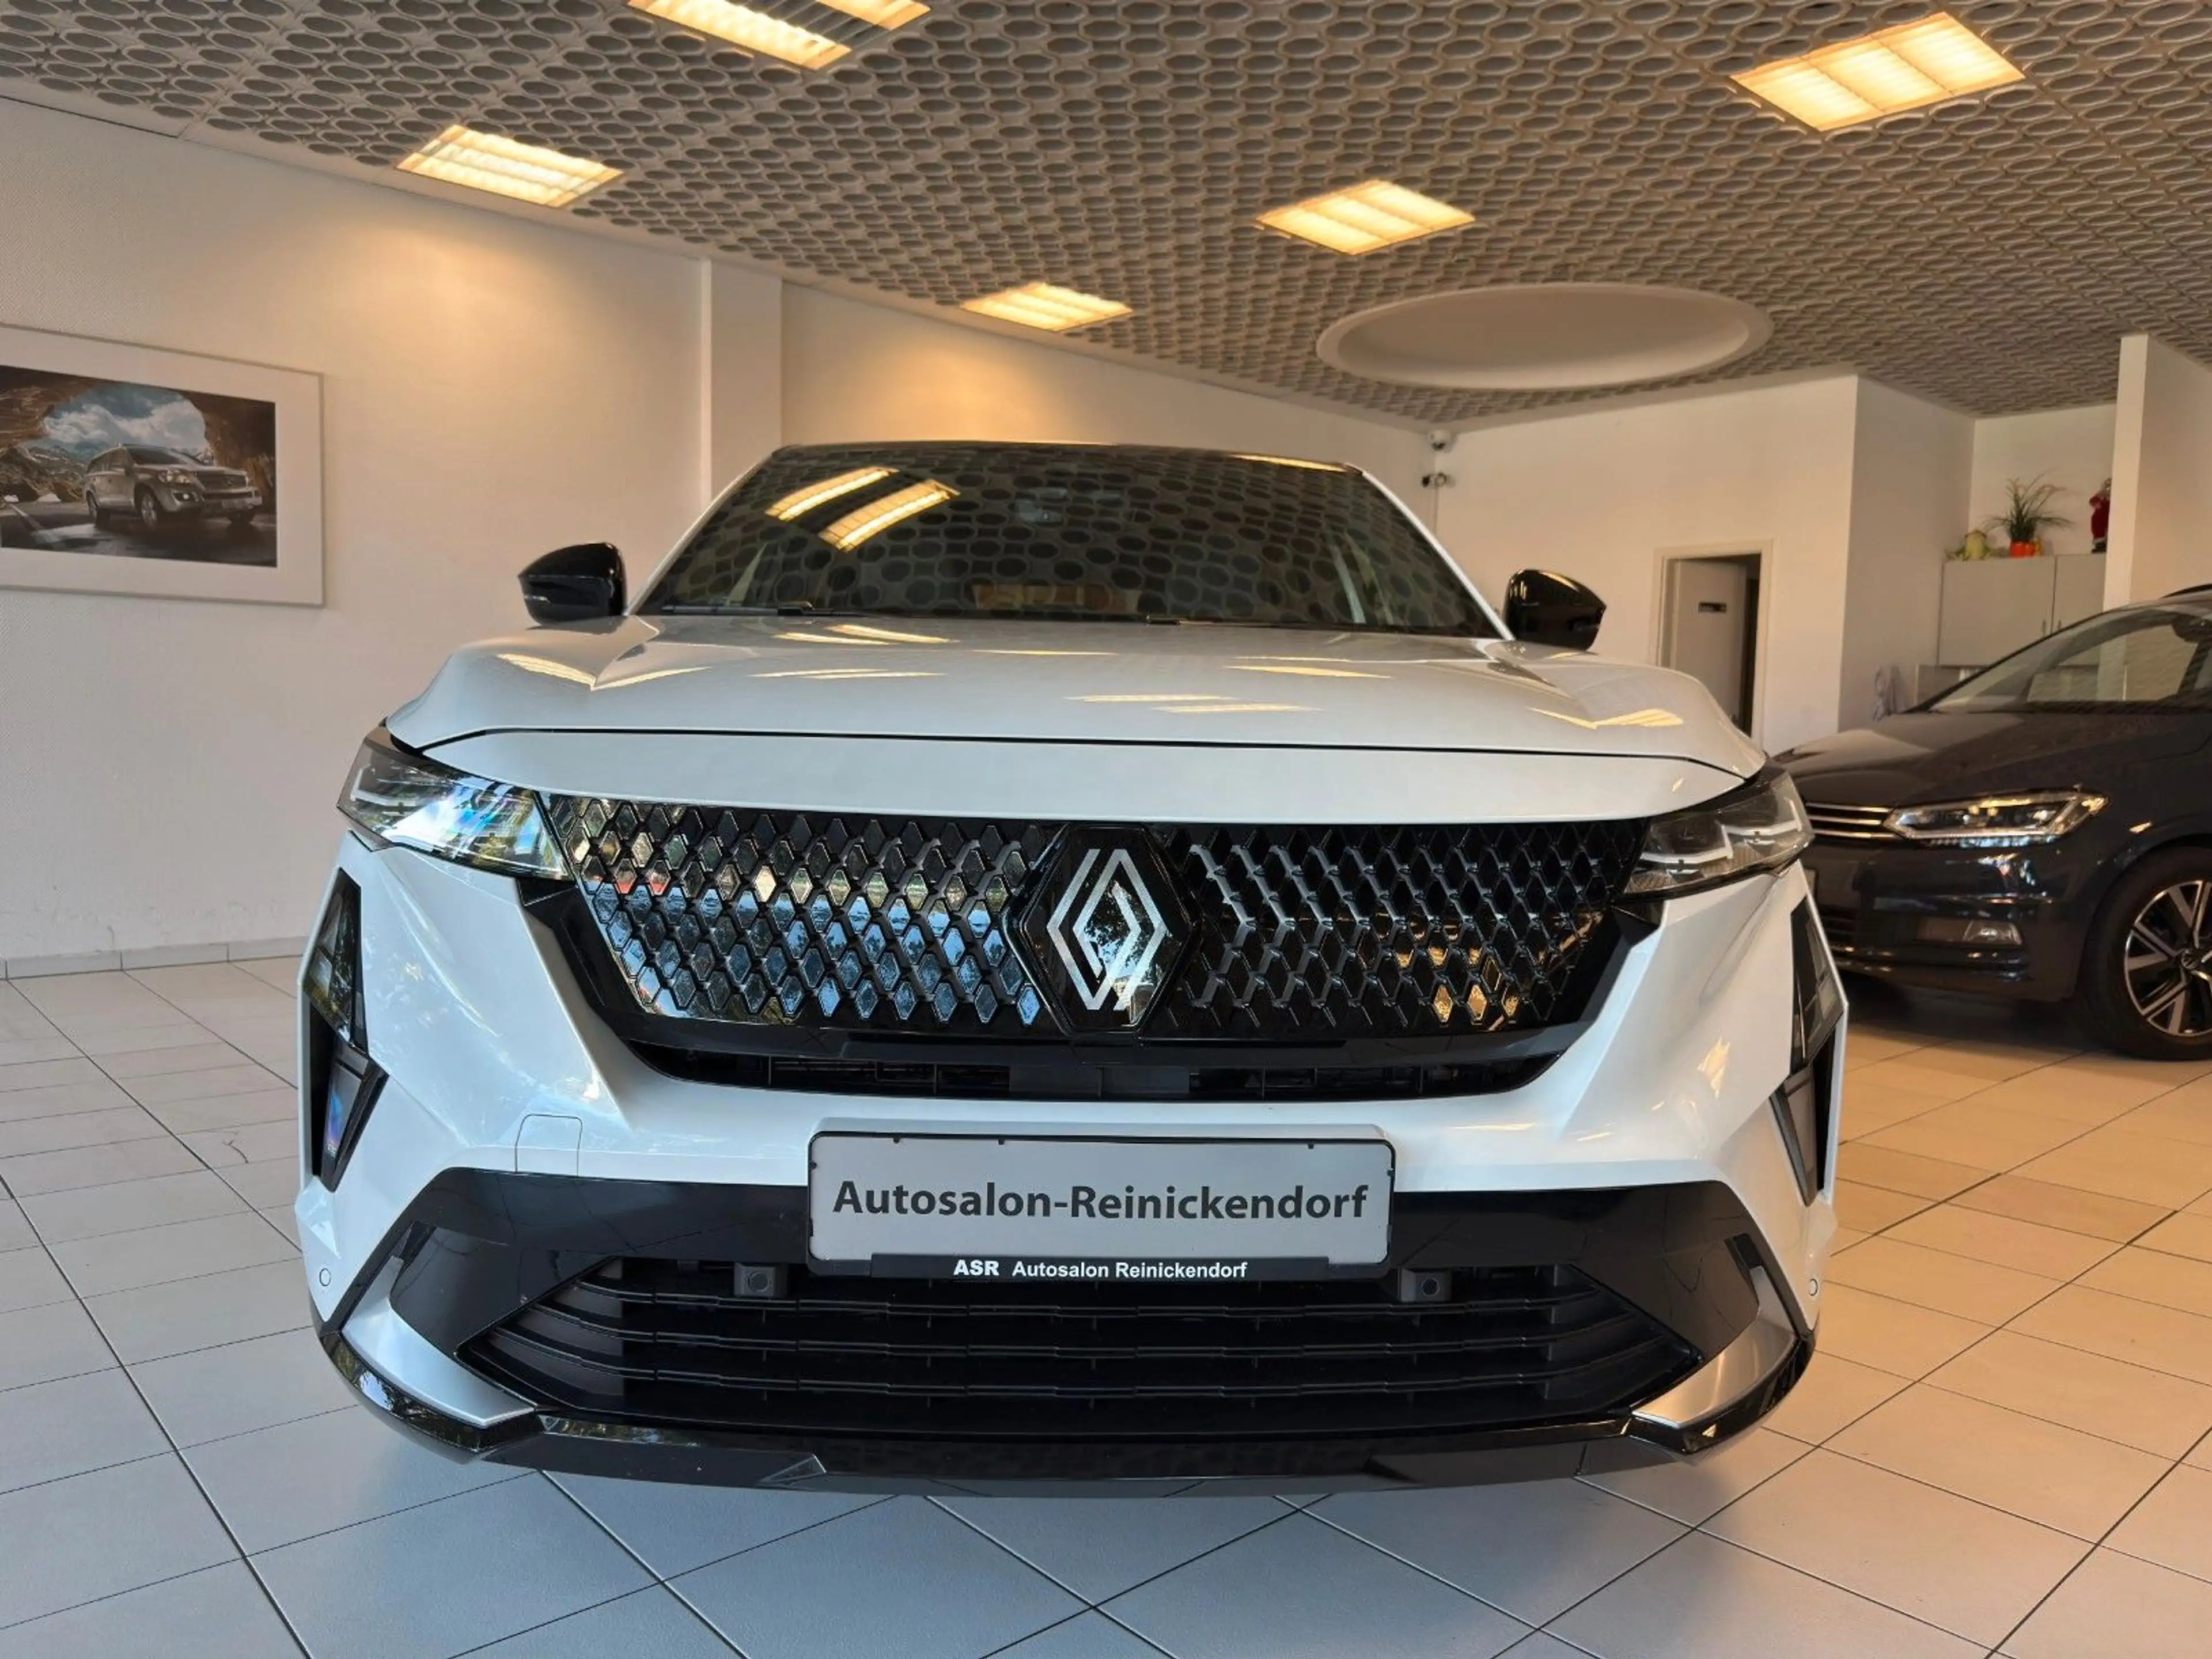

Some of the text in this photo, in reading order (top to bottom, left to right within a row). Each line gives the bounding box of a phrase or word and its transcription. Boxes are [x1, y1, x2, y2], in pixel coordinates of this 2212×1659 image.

[833, 1181, 1369, 1219] Autosalon-Reinickendorf
[953, 1259, 1248, 1278] ASR Autosalon Reinickendorf
